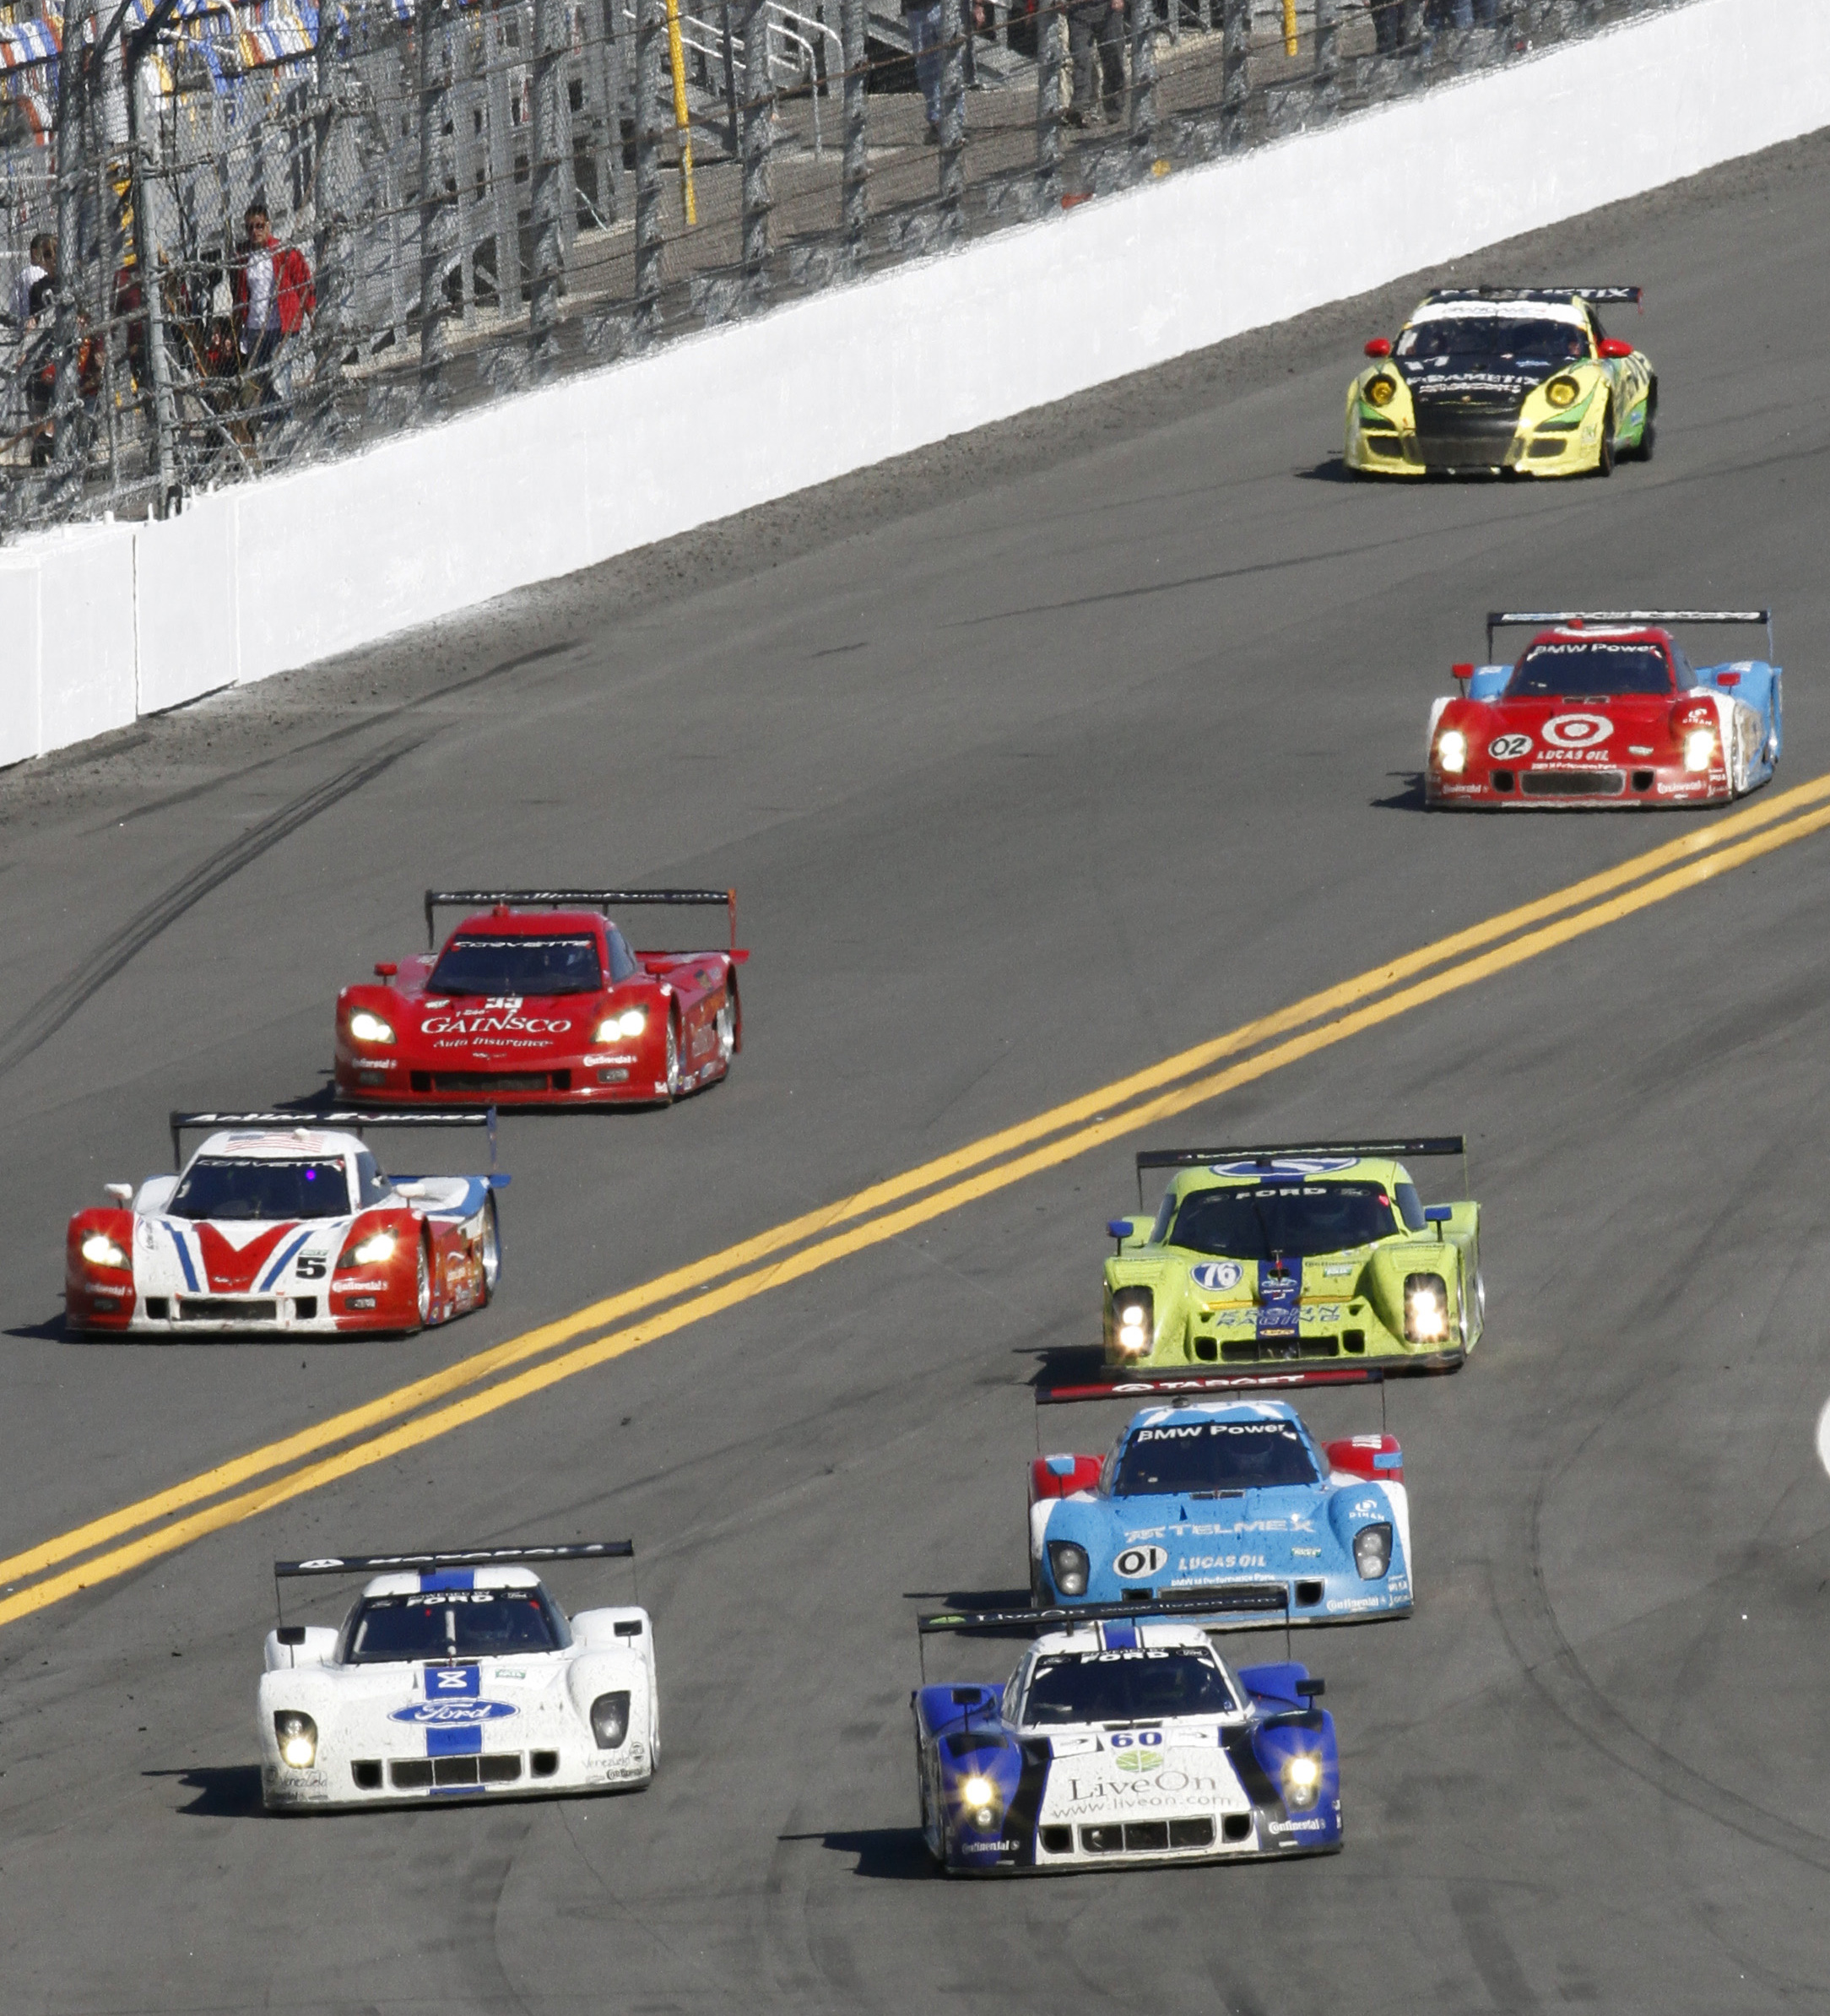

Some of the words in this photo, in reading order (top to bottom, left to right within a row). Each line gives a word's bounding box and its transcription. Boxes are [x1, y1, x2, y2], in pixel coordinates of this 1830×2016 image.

[1535, 644, 1587, 653] BMW
[1591, 644, 1656, 653] Power
[1492, 738, 1525, 756] 02
[1536, 750, 1583, 760] LUCAS
[1586, 750, 1609, 761] OIL
[421, 1016, 571, 1033] GAINSCO
[433, 1038, 468, 1048] Auto
[472, 1037, 554, 1047] Insurance
[1235, 1187, 1327, 1200] FORD
[295, 1256, 327, 1279] 5
[1200, 1262, 1236, 1287] 76
[1159, 1374, 1305, 1389] TARGET
[1137, 1426, 1203, 1443] BMW
[1210, 1423, 1286, 1436] Power
[1168, 1520, 1315, 1536] TELMEX
[1178, 1556, 1237, 1570] LUCAS
[1237, 1554, 1266, 1568] OIL
[407, 1595, 495, 1607] FORD
[1080, 1652, 1169, 1664] FORD
[414, 1704, 492, 1721] Ford
[1111, 1731, 1162, 1748] 60
[1069, 1770, 1216, 1801] LiveOn
[1053, 1794, 1232, 1819] www.liveon.com
[1269, 1818, 1319, 1834] Continental
